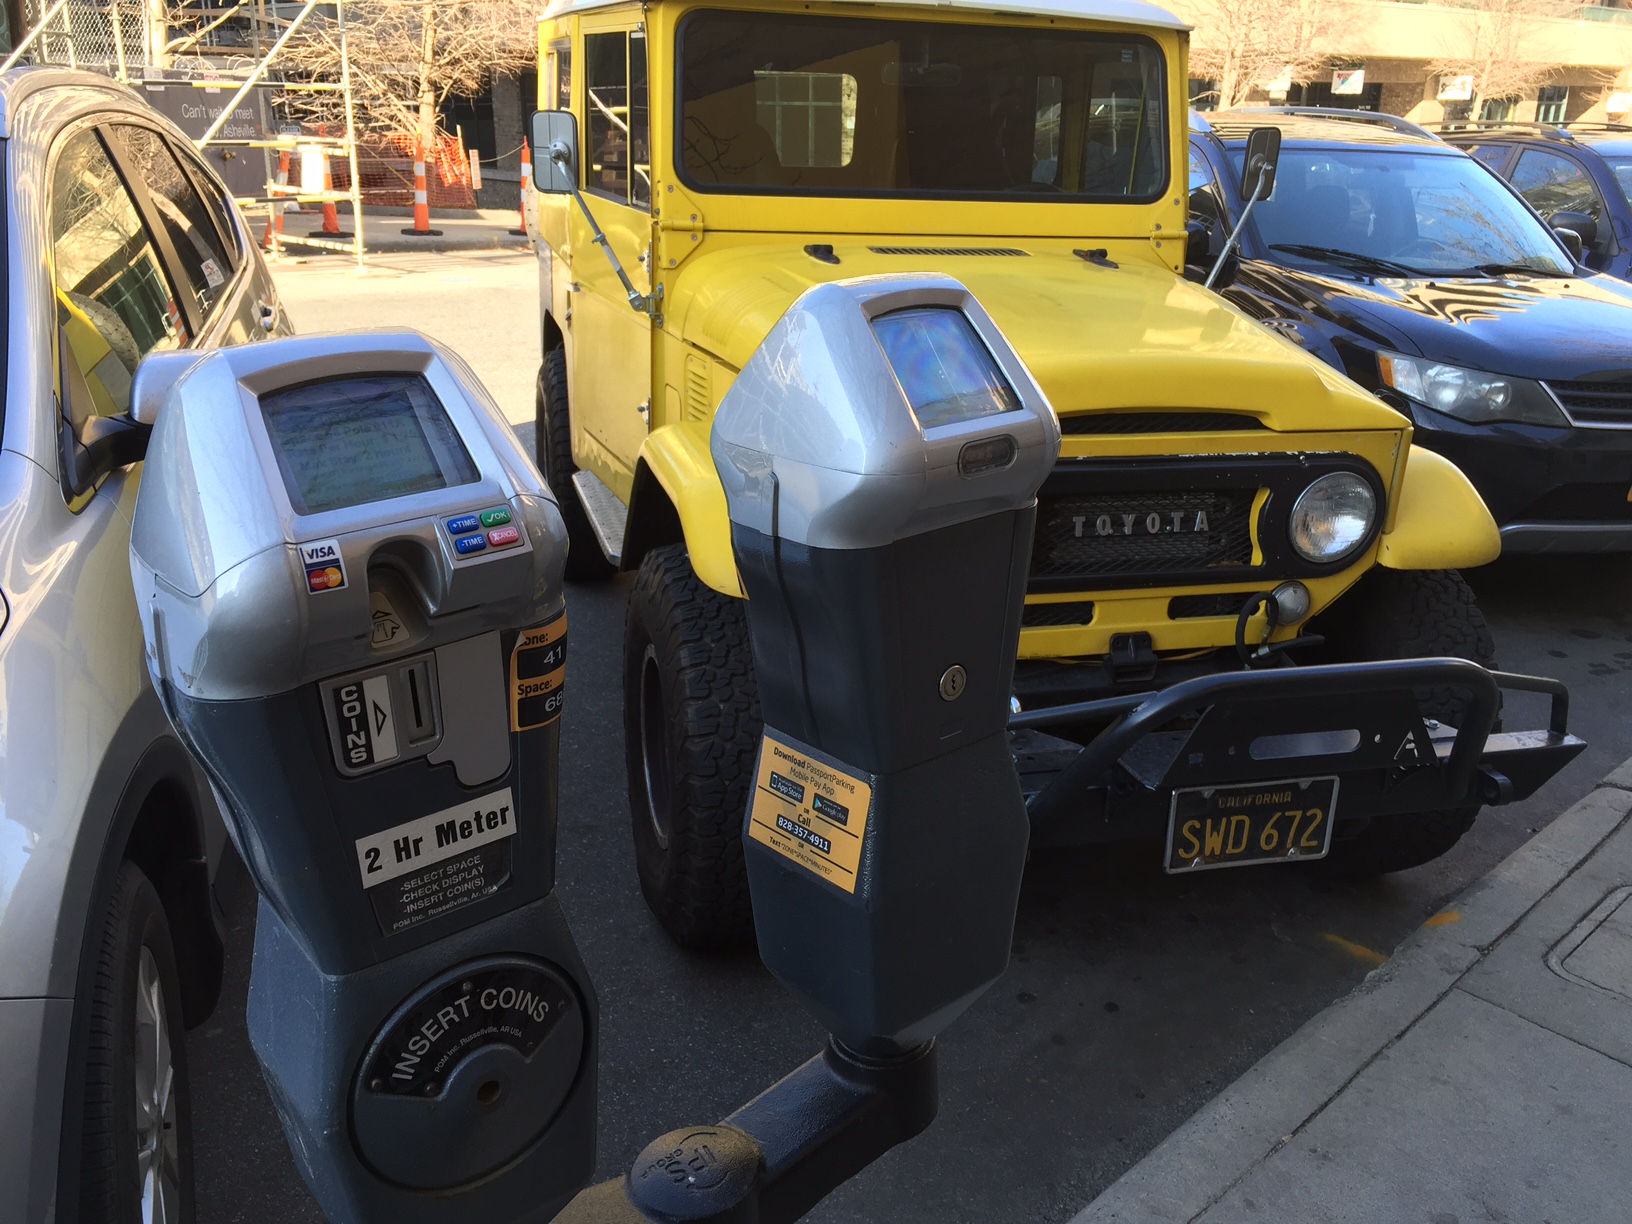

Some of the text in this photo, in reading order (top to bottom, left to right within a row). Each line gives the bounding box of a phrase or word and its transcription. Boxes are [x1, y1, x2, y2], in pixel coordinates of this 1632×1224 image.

[181, 104, 206, 118] Can't
[234, 108, 254, 120] meet
[224, 124, 256, 138] Asheville.
[495, 512, 507, 520] OK
[1072, 510, 1209, 538] TOYOTA
[306, 546, 336, 560] VISA
[310, 573, 342, 584] MasterCard
[520, 632, 548, 646] one:
[544, 646, 562, 664] 41
[518, 680, 552, 698] Space:
[340, 685, 368, 764] COINS
[774, 746, 806, 769] Download
[806, 762, 856, 794] PassportParking
[777, 782, 788, 794] App
[788, 788, 802, 800] Store
[790, 766, 808, 784] Mobile
[810, 776, 820, 790] Pay
[822, 783, 835, 797] App
[1218, 791, 1292, 808] CALIFORNIA
[804, 807, 810, 815] OR
[797, 814, 811, 828] Call
[364, 806, 510, 874] 2 Hr Meter
[769, 836, 780, 848] Text
[778, 816, 828, 851] 828-357-4911
[1178, 808, 1323, 859] SWD 672
[446, 854, 481, 874] SPACE
[442, 864, 485, 888] DISPLAY
[448, 876, 485, 898] COIN(S)
[393, 918, 411, 930] POM
[412, 914, 425, 923] Inc.
[482, 884, 498, 895] USA
[392, 987, 549, 1080] INSERT COINS
[434, 1055, 450, 1073] POM
[510, 1027, 522, 1038] USA
